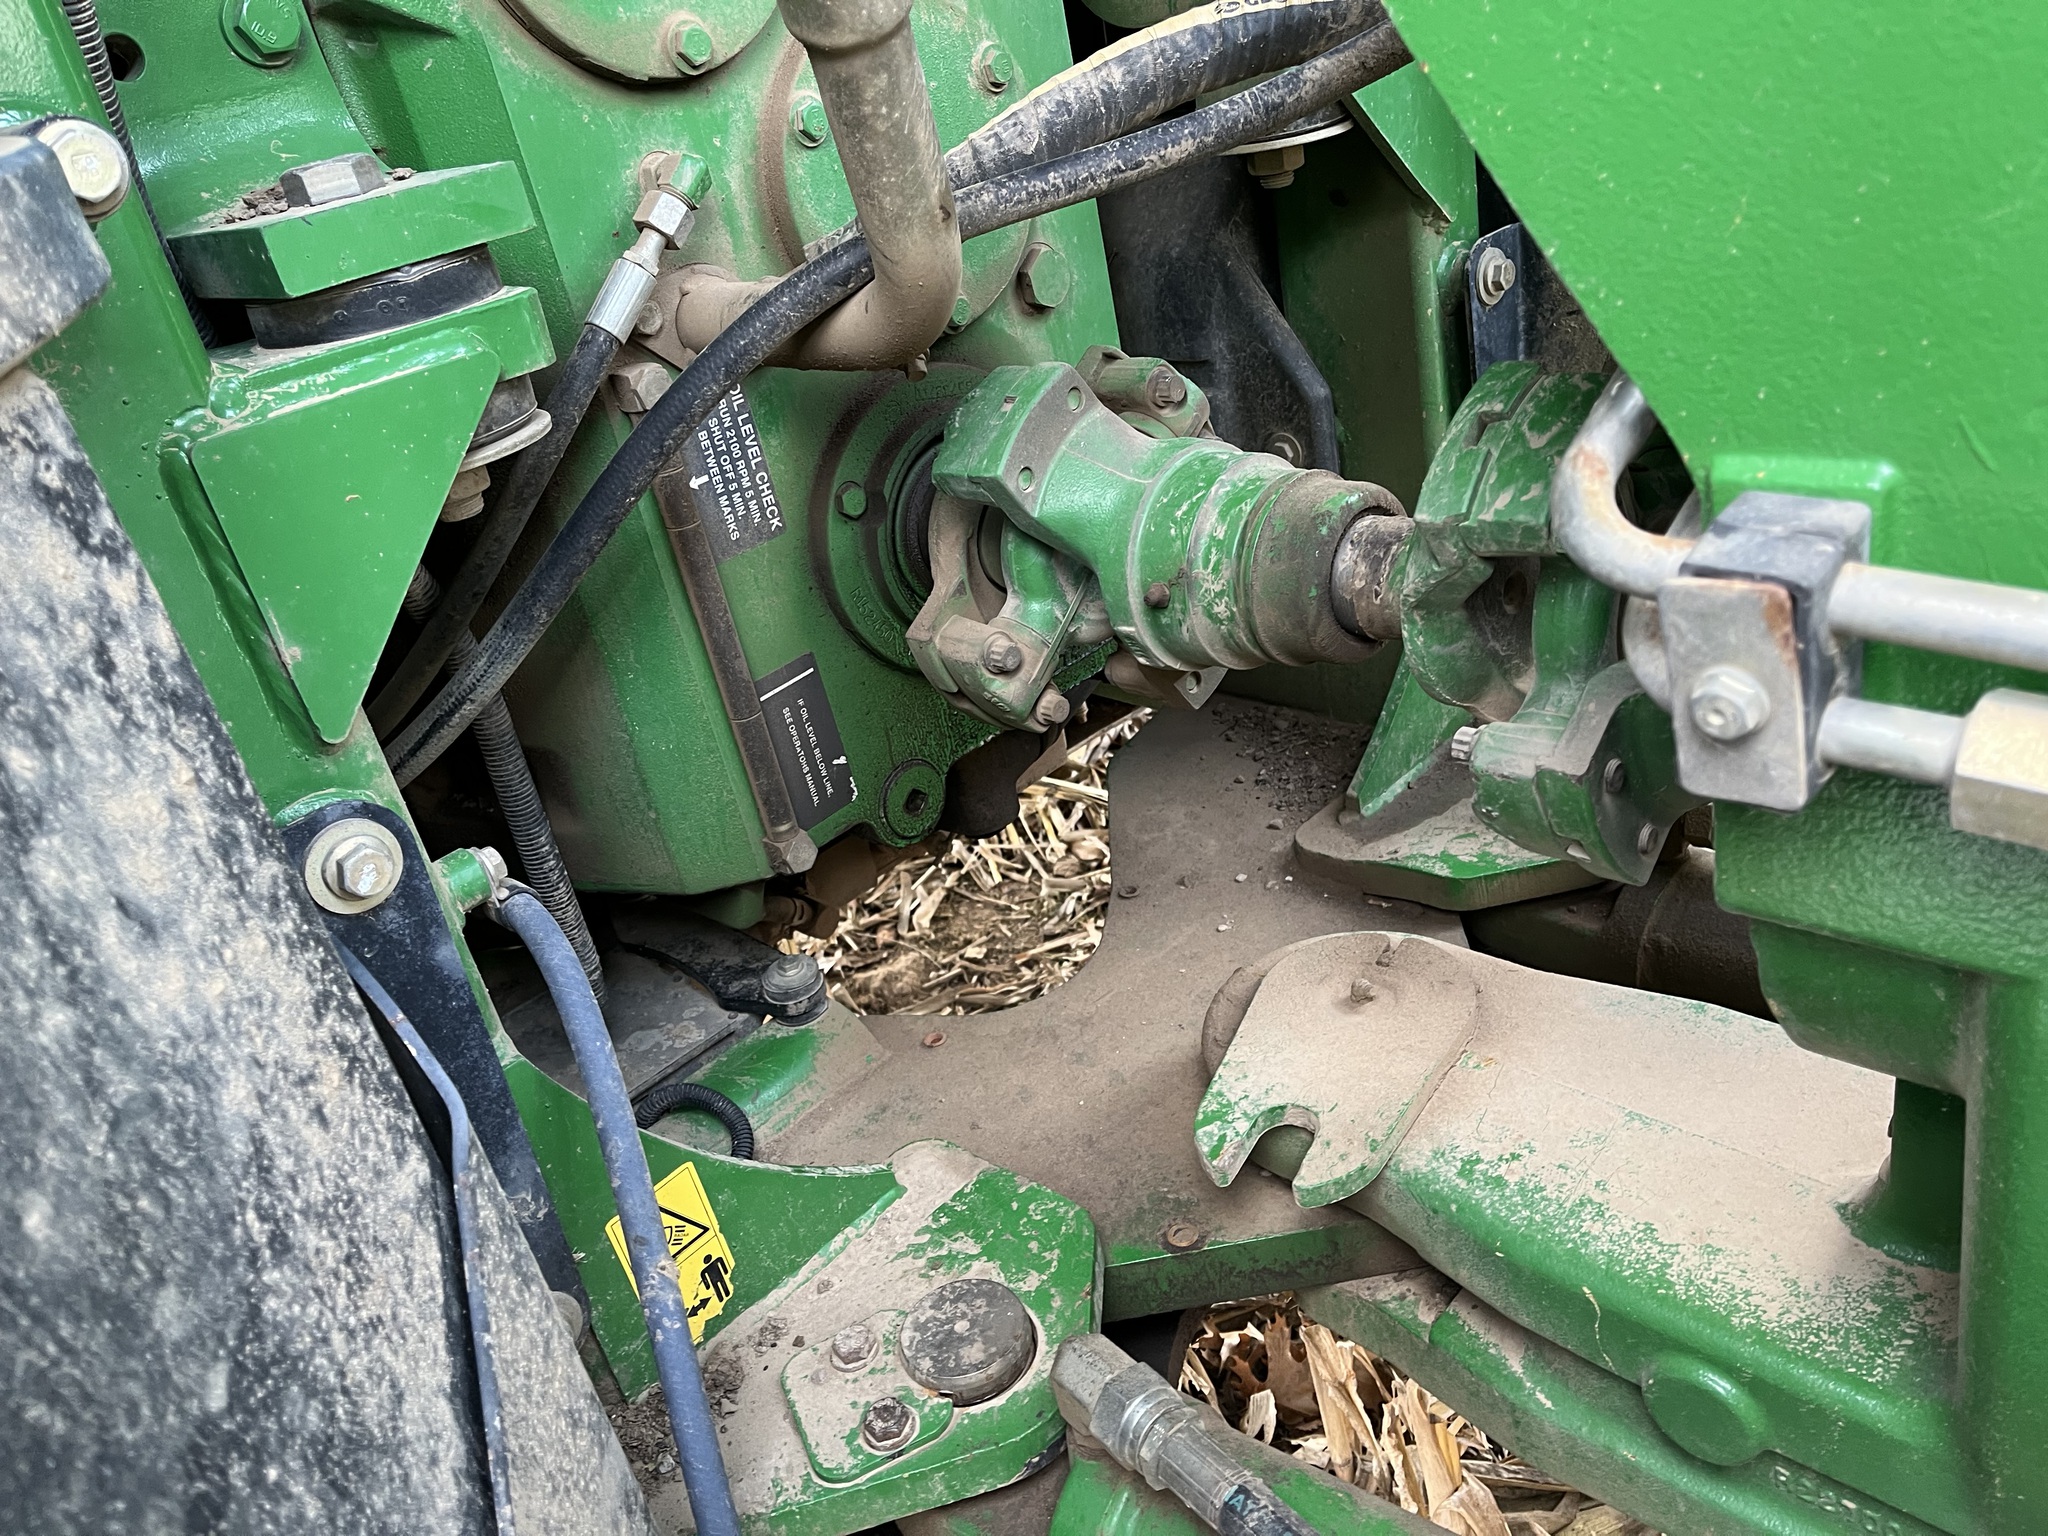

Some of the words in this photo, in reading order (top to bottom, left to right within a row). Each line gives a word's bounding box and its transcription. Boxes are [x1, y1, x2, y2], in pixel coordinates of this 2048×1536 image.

[718, 398, 733, 427] RUN
[708, 417, 727, 452] SHUT
[725, 429, 742, 459] 2100
[720, 455, 735, 480] OFF
[736, 459, 752, 489] RPM
[737, 413, 763, 470] LEVEL
[755, 471, 783, 532] CHECK
[697, 430, 726, 496] BETWEEN
[718, 495, 740, 541] MARKS
[728, 482, 739, 492] 5
[744, 490, 755, 498] 5
[731, 494, 747, 520] MIN.
[749, 499, 762, 527] MIN.
[797, 698, 804, 706] IF
[800, 708, 809, 722] OIL
[804, 722, 818, 748] LEVEL
[782, 707, 793, 724] SEE
[804, 773, 820, 807] MANUAL
[813, 747, 828, 776] BELOW
